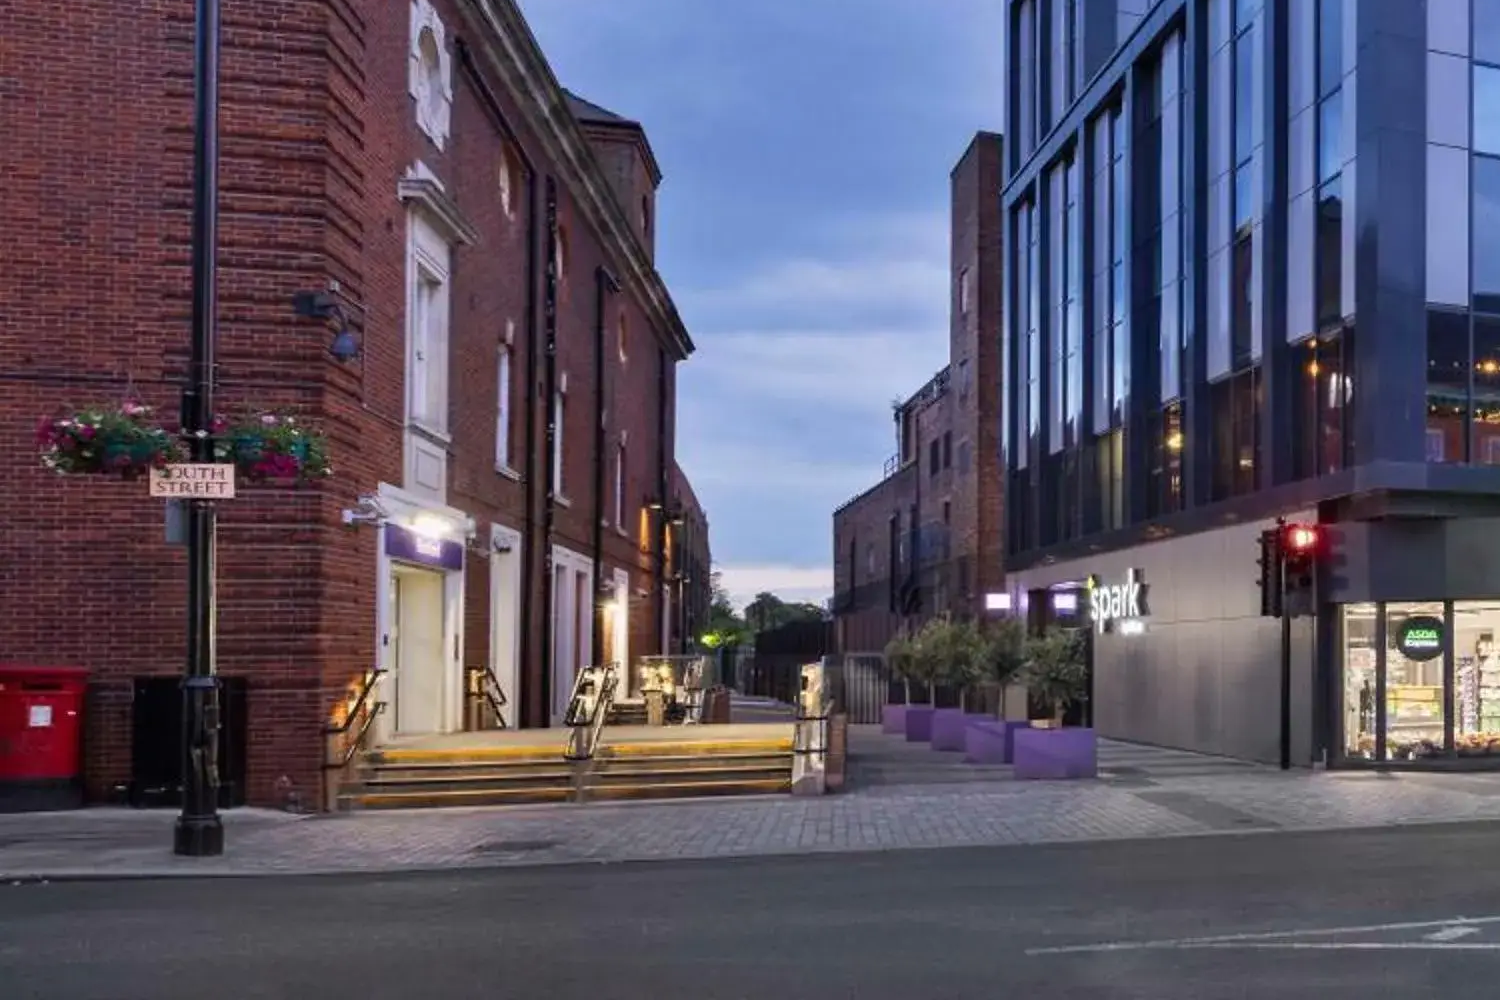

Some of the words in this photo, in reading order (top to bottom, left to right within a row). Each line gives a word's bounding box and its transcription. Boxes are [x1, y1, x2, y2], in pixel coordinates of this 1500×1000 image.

[158, 467, 225, 480] OUTH
[156, 481, 228, 494] STREET
[1090, 567, 1141, 634] spark
[1406, 629, 1438, 639] ASDA
